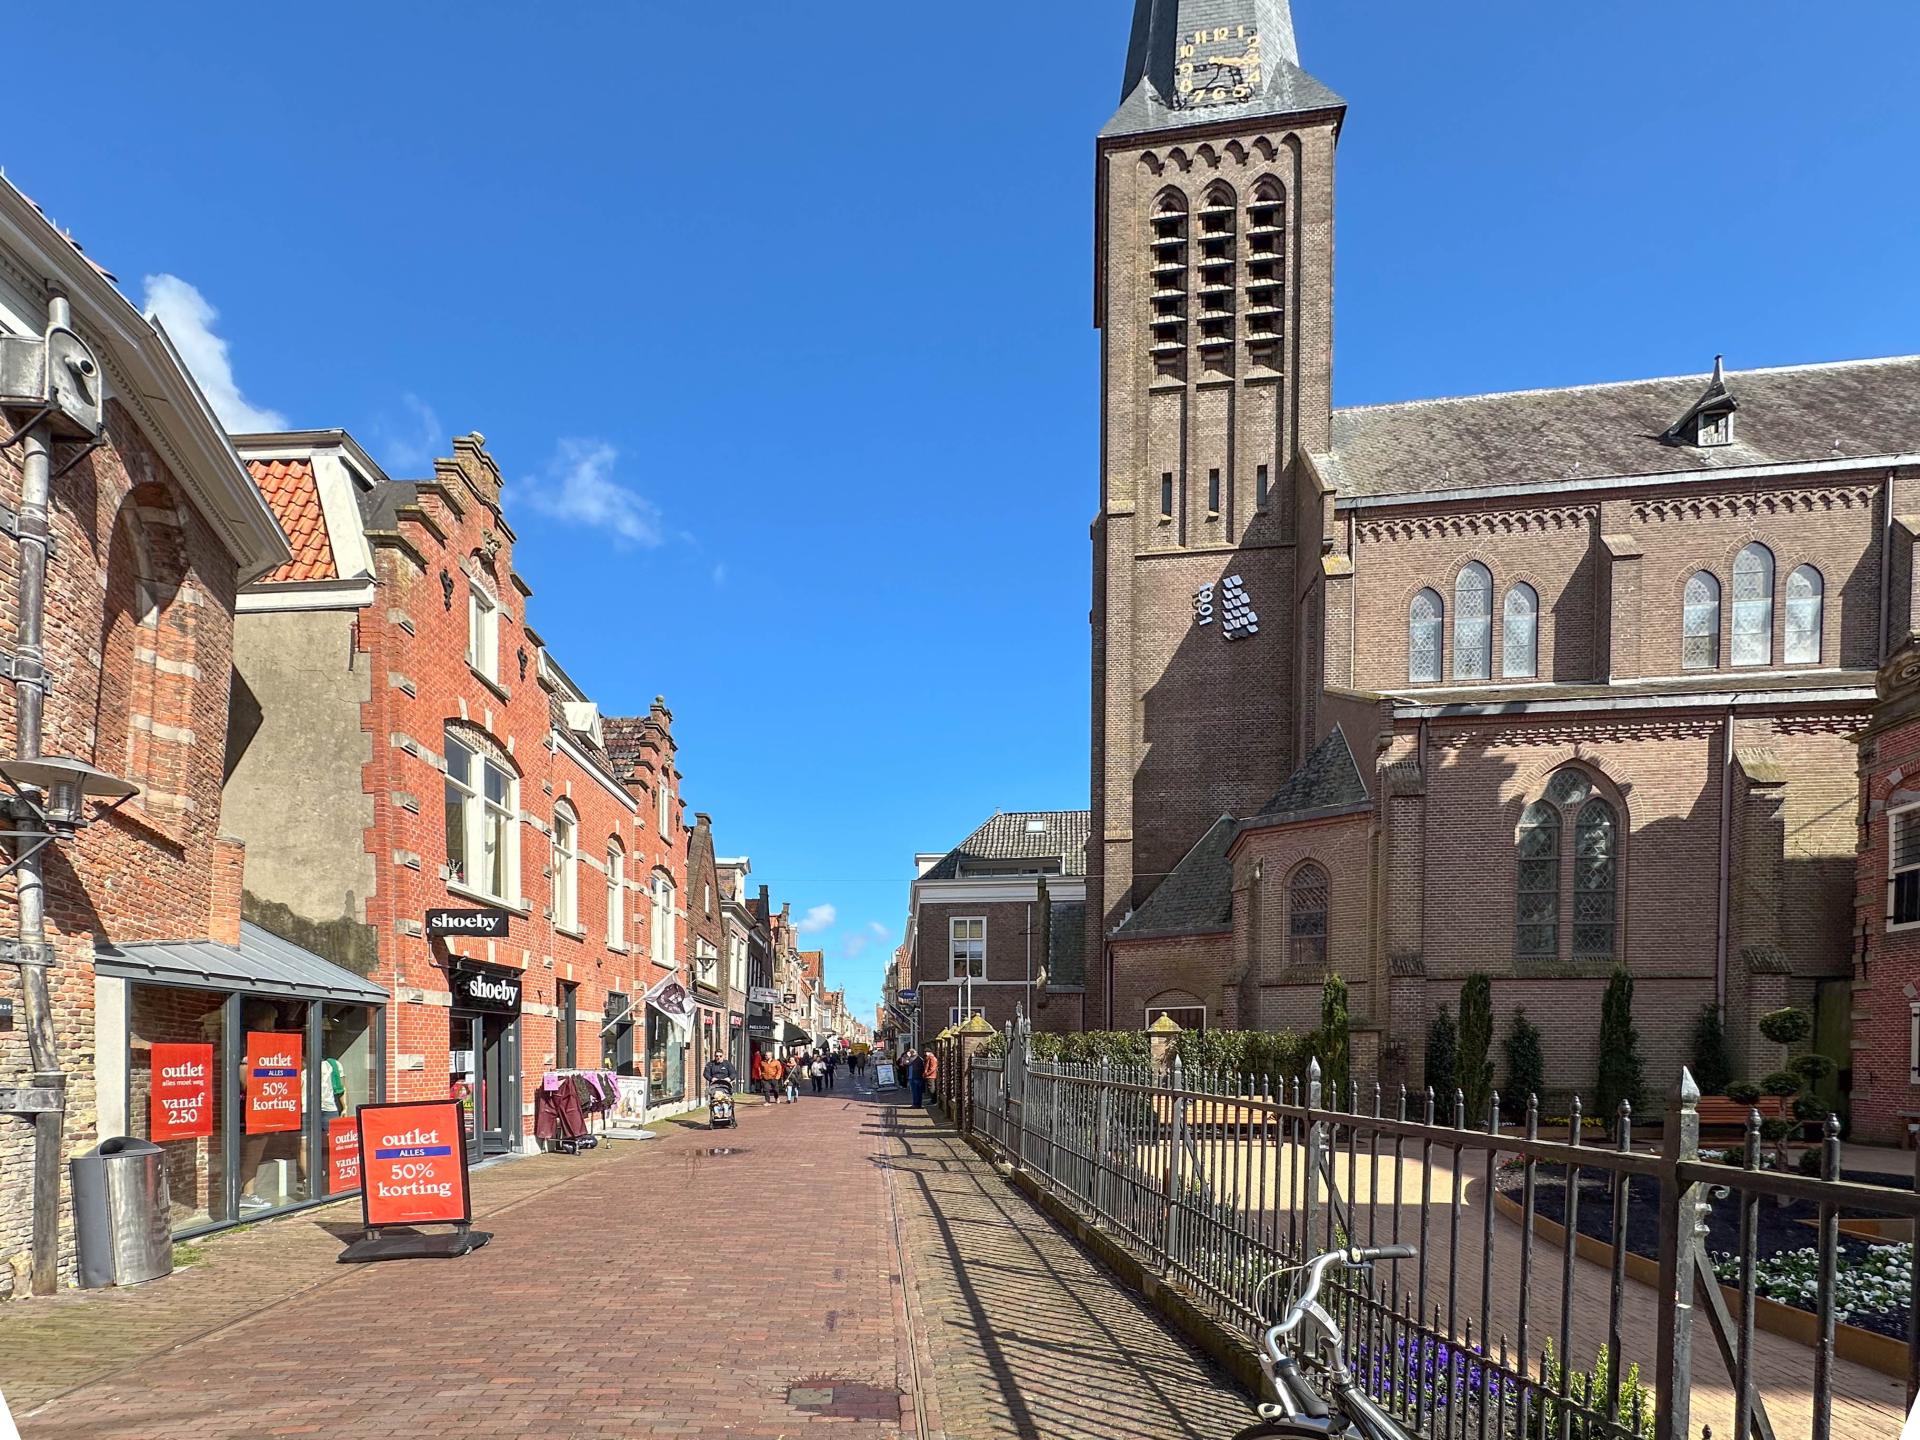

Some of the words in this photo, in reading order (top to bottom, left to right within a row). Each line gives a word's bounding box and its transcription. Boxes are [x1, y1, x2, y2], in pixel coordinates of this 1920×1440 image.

[1194, 30, 1207, 44] 11
[1213, 27, 1229, 42] 12
[1237, 25, 1244, 38] 1
[1247, 36, 1260, 49] 2
[1180, 44, 1194, 58] 10
[1180, 63, 1193, 76] 9
[1248, 70, 1260, 83] 4
[1180, 80, 1194, 93] 8
[1212, 87, 1226, 100] 6
[1233, 83, 1247, 98] 5
[1193, 90, 1206, 103] 7
[431, 913, 500, 931] shoeby
[469, 975, 518, 1006] shoeby
[258, 1053, 292, 1067] outlet
[162, 1062, 204, 1078] outlet
[268, 1069, 284, 1077] ALLES
[262, 1082, 288, 1096] 50%
[162, 1092, 205, 1109] vanaf
[253, 1097, 297, 1112] korting
[168, 1108, 198, 1125] 2.50
[335, 1131, 358, 1145] outle
[382, 1128, 439, 1146] outlet
[399, 1149, 425, 1157] ALLES
[339, 1167, 357, 1180] 2.50
[391, 1162, 434, 1180] 50%
[377, 1180, 452, 1198] korting
